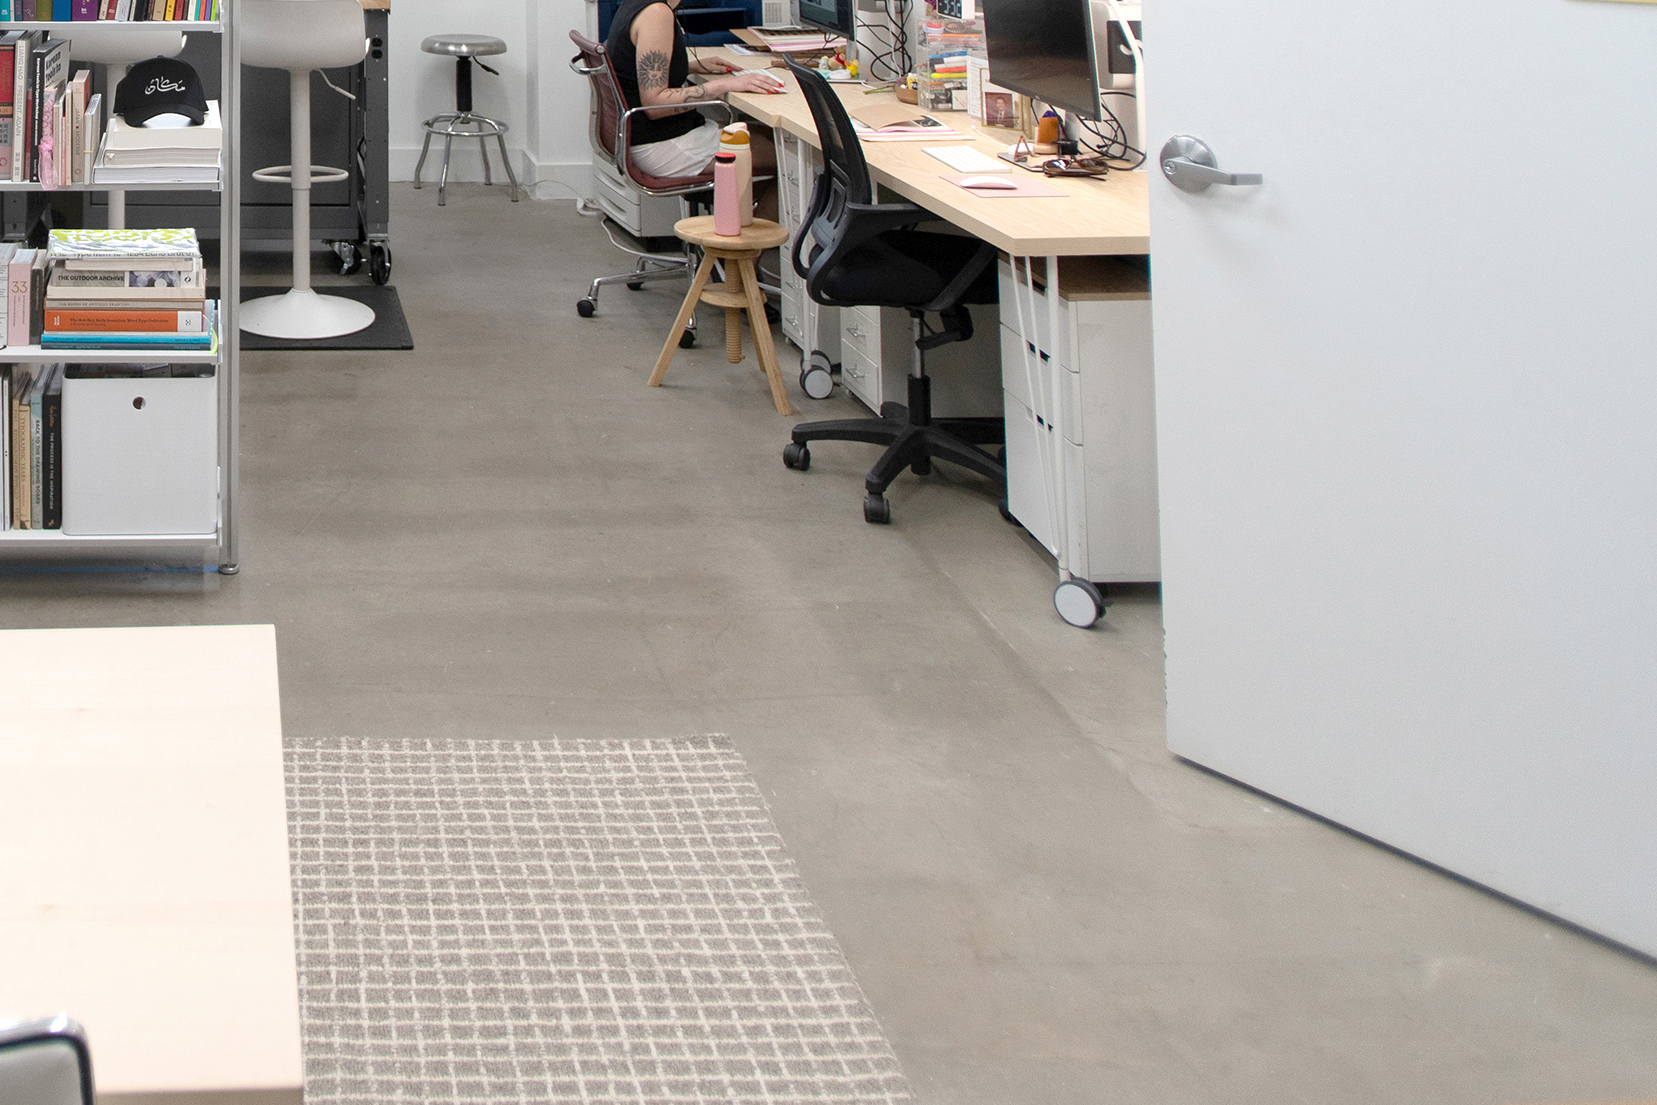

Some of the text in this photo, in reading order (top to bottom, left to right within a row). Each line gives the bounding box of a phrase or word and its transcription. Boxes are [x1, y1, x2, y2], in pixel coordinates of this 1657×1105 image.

[16, 46, 25, 64] LIANG
[17, 66, 25, 80] HAO
[16, 116, 24, 137] AGAIN
[11, 281, 28, 294] 33
